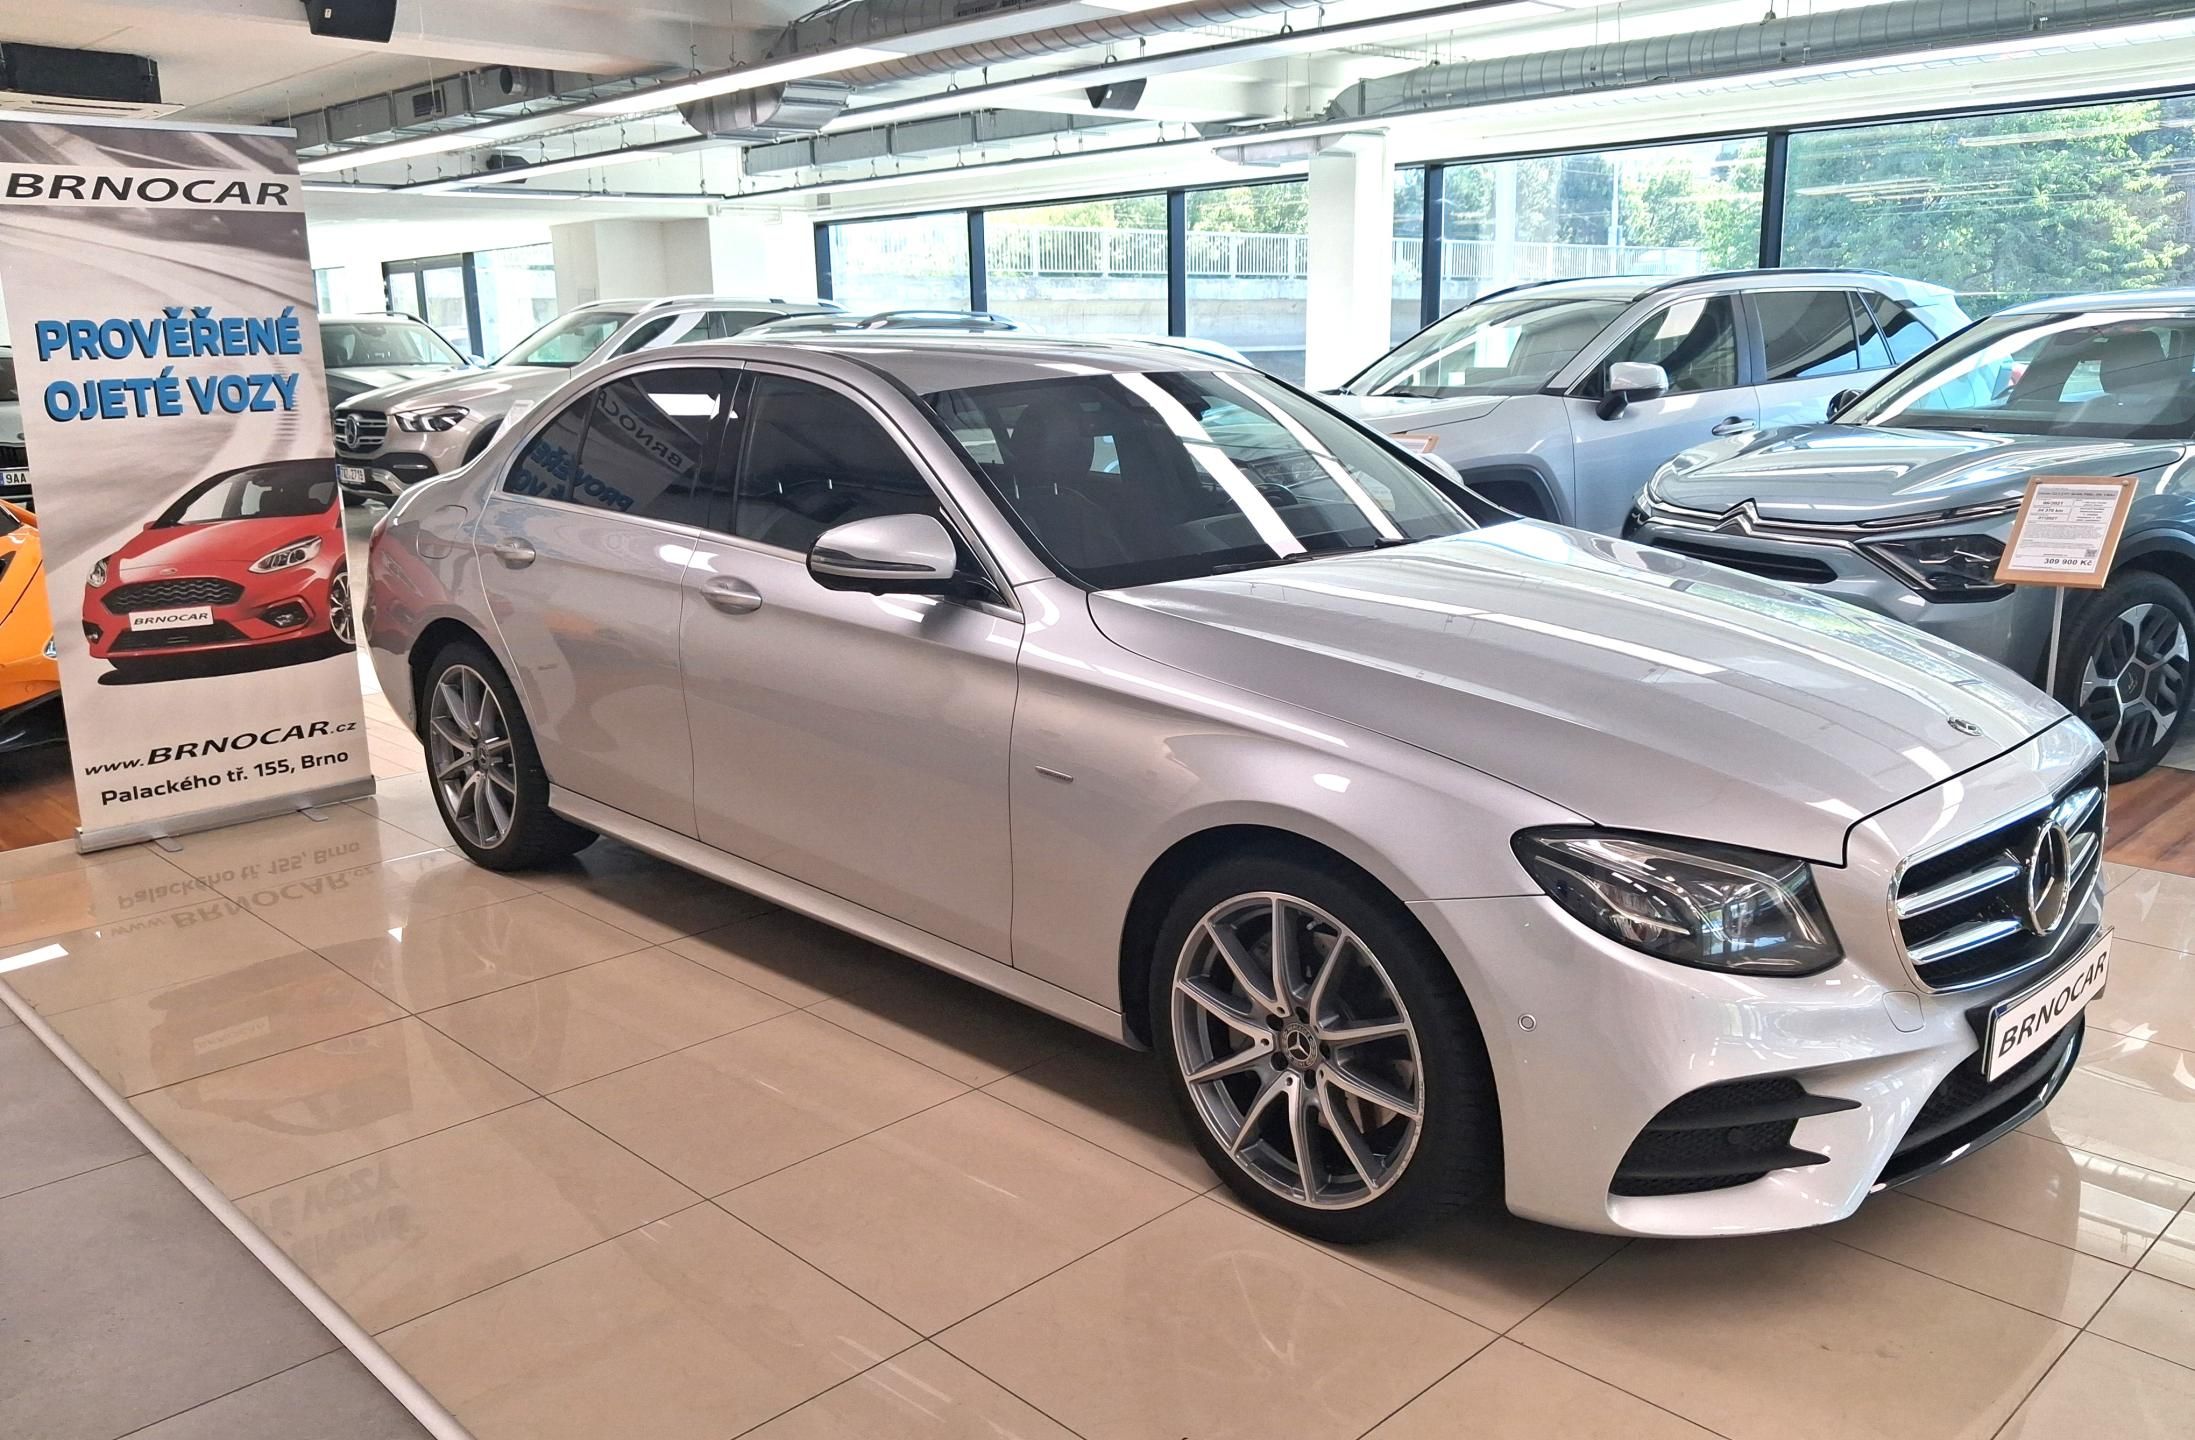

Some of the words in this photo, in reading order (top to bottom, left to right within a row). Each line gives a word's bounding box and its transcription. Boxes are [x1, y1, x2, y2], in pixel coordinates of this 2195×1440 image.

[5, 172, 290, 206] BRNOCAR
[34, 306, 303, 361] PROVĚŘENÉ
[44, 366, 184, 422] OJETÉ
[186, 373, 300, 415] VOZY
[5, 473, 27, 484] 9AA
[2062, 558, 2078, 566] 900
[133, 611, 209, 626] BRNOCAR
[85, 720, 357, 776] www.BRNOCAR.cz
[101, 773, 221, 806] Palackého
[227, 767, 248, 786] tř.
[254, 758, 295, 778] 155,
[301, 751, 349, 770] Brno
[1998, 951, 2108, 1058] BRNOCAR
